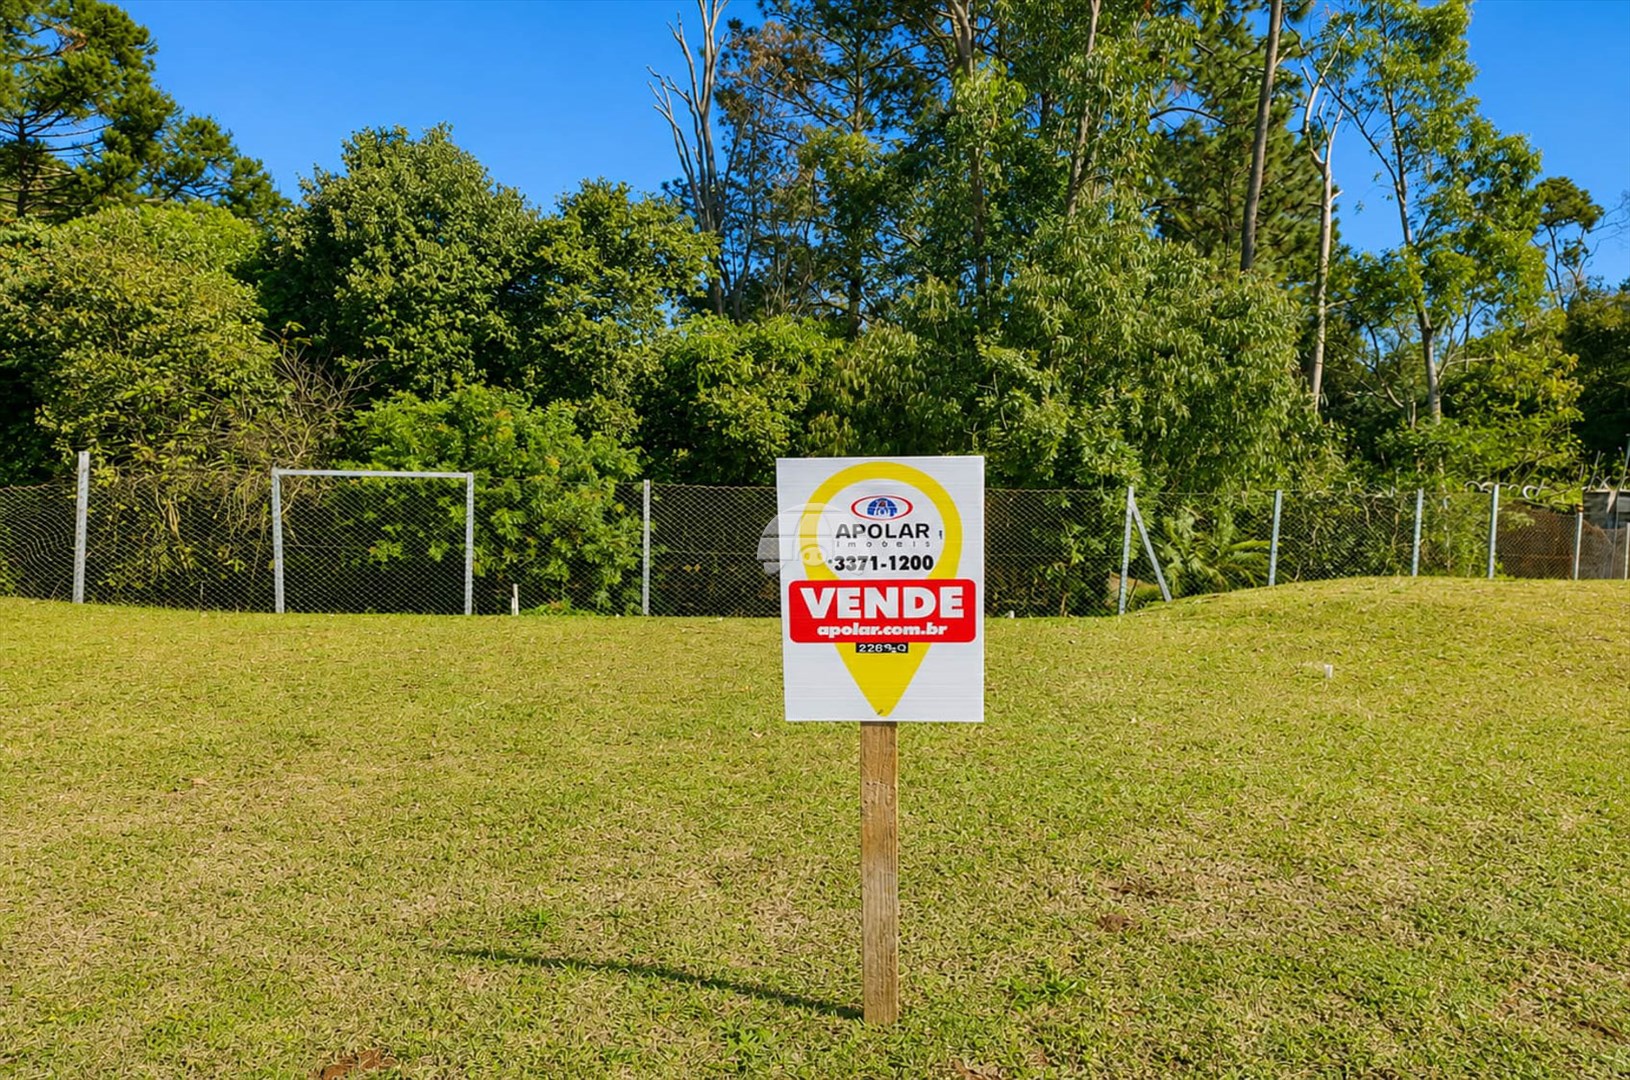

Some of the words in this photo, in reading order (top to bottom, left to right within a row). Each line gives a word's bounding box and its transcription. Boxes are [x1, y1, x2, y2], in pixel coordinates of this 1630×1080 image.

[837, 523, 930, 539] APOLAR
[834, 555, 934, 571] 3371-1200
[800, 586, 964, 619] VENDE
[817, 622, 947, 638] apolar.com.br
